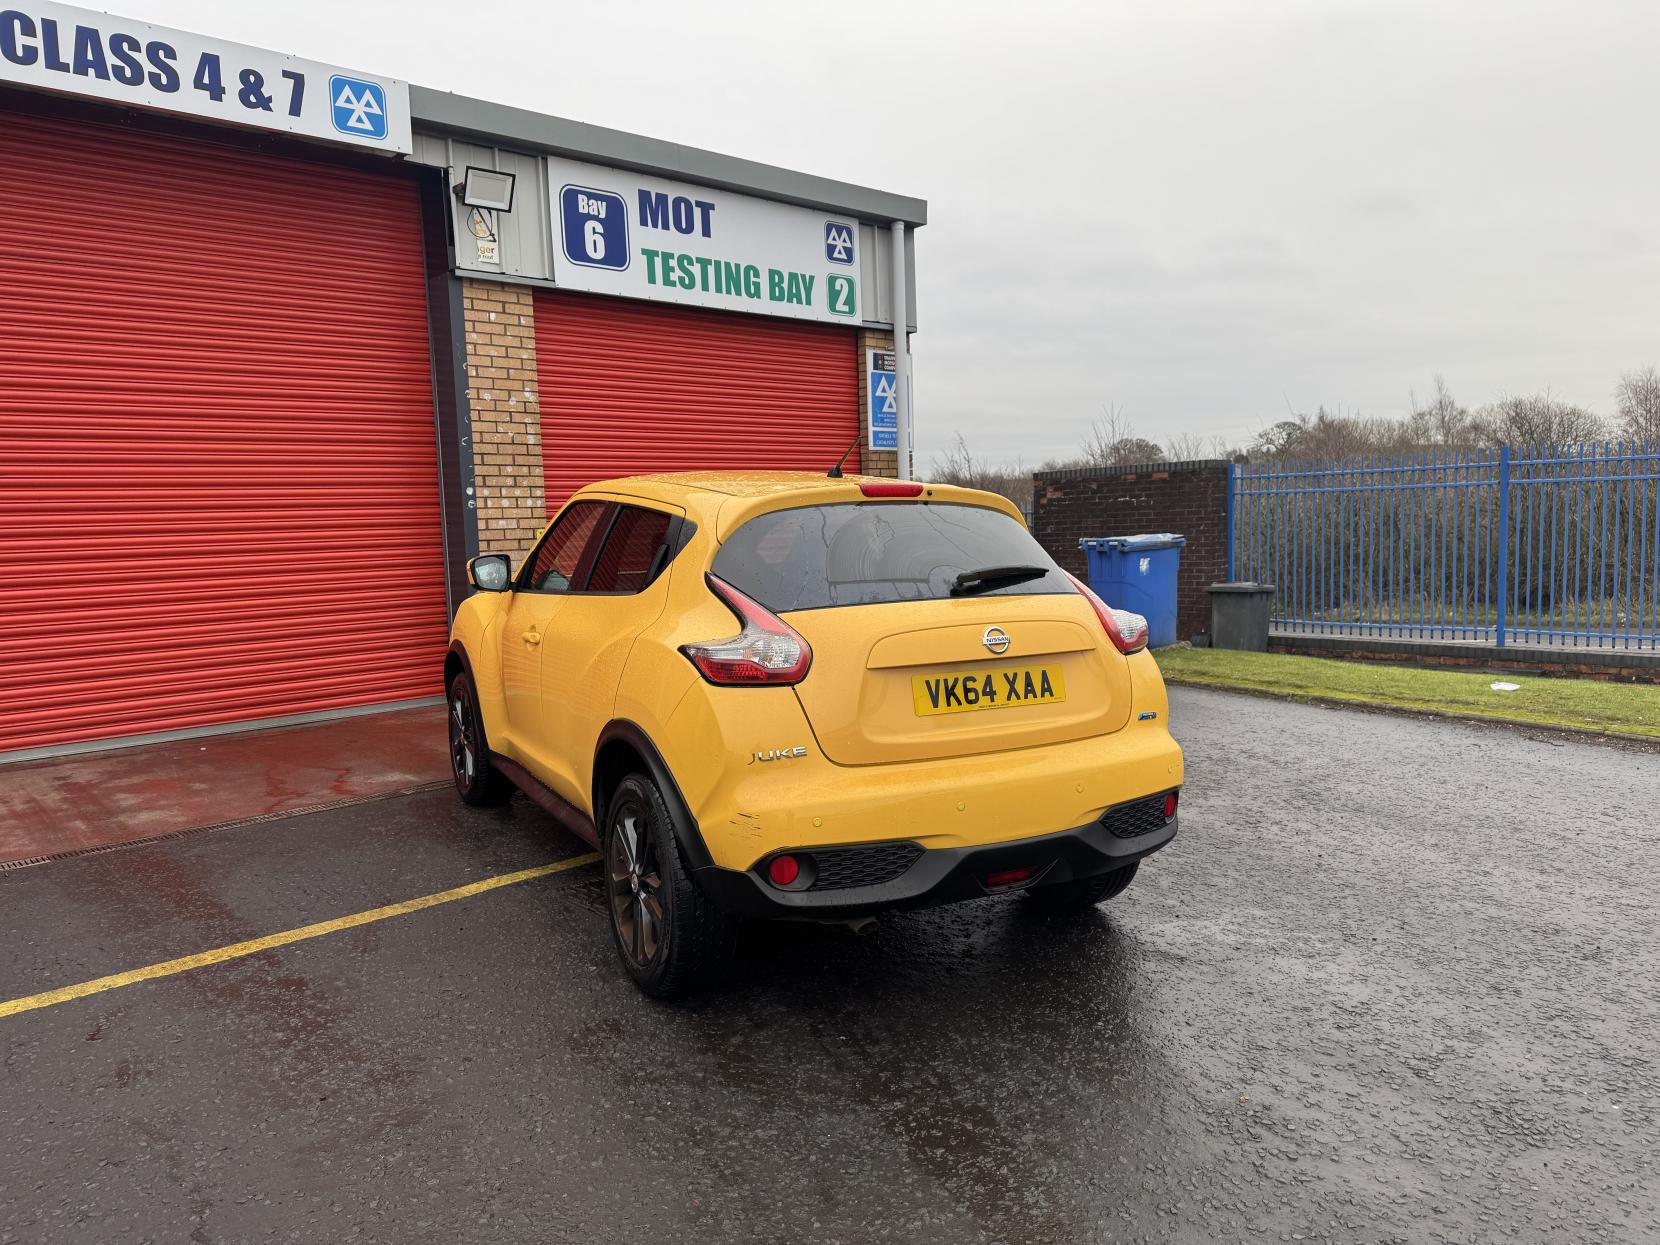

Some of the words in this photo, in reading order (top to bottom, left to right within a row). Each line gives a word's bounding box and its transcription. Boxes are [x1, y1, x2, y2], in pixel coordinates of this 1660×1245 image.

[0, 10, 181, 94] CLASS
[193, 52, 226, 102] 4
[238, 68, 273, 113] &
[282, 70, 305, 118] 7
[578, 194, 607, 219] Bay
[638, 189, 715, 238] MOT
[584, 220, 605, 260] 6
[641, 248, 761, 300] TESTING
[768, 268, 815, 307] BAY
[835, 278, 849, 313] 2
[925, 674, 997, 709] VK64
[1003, 669, 1054, 701] XAA
[747, 746, 807, 766] JUKE
